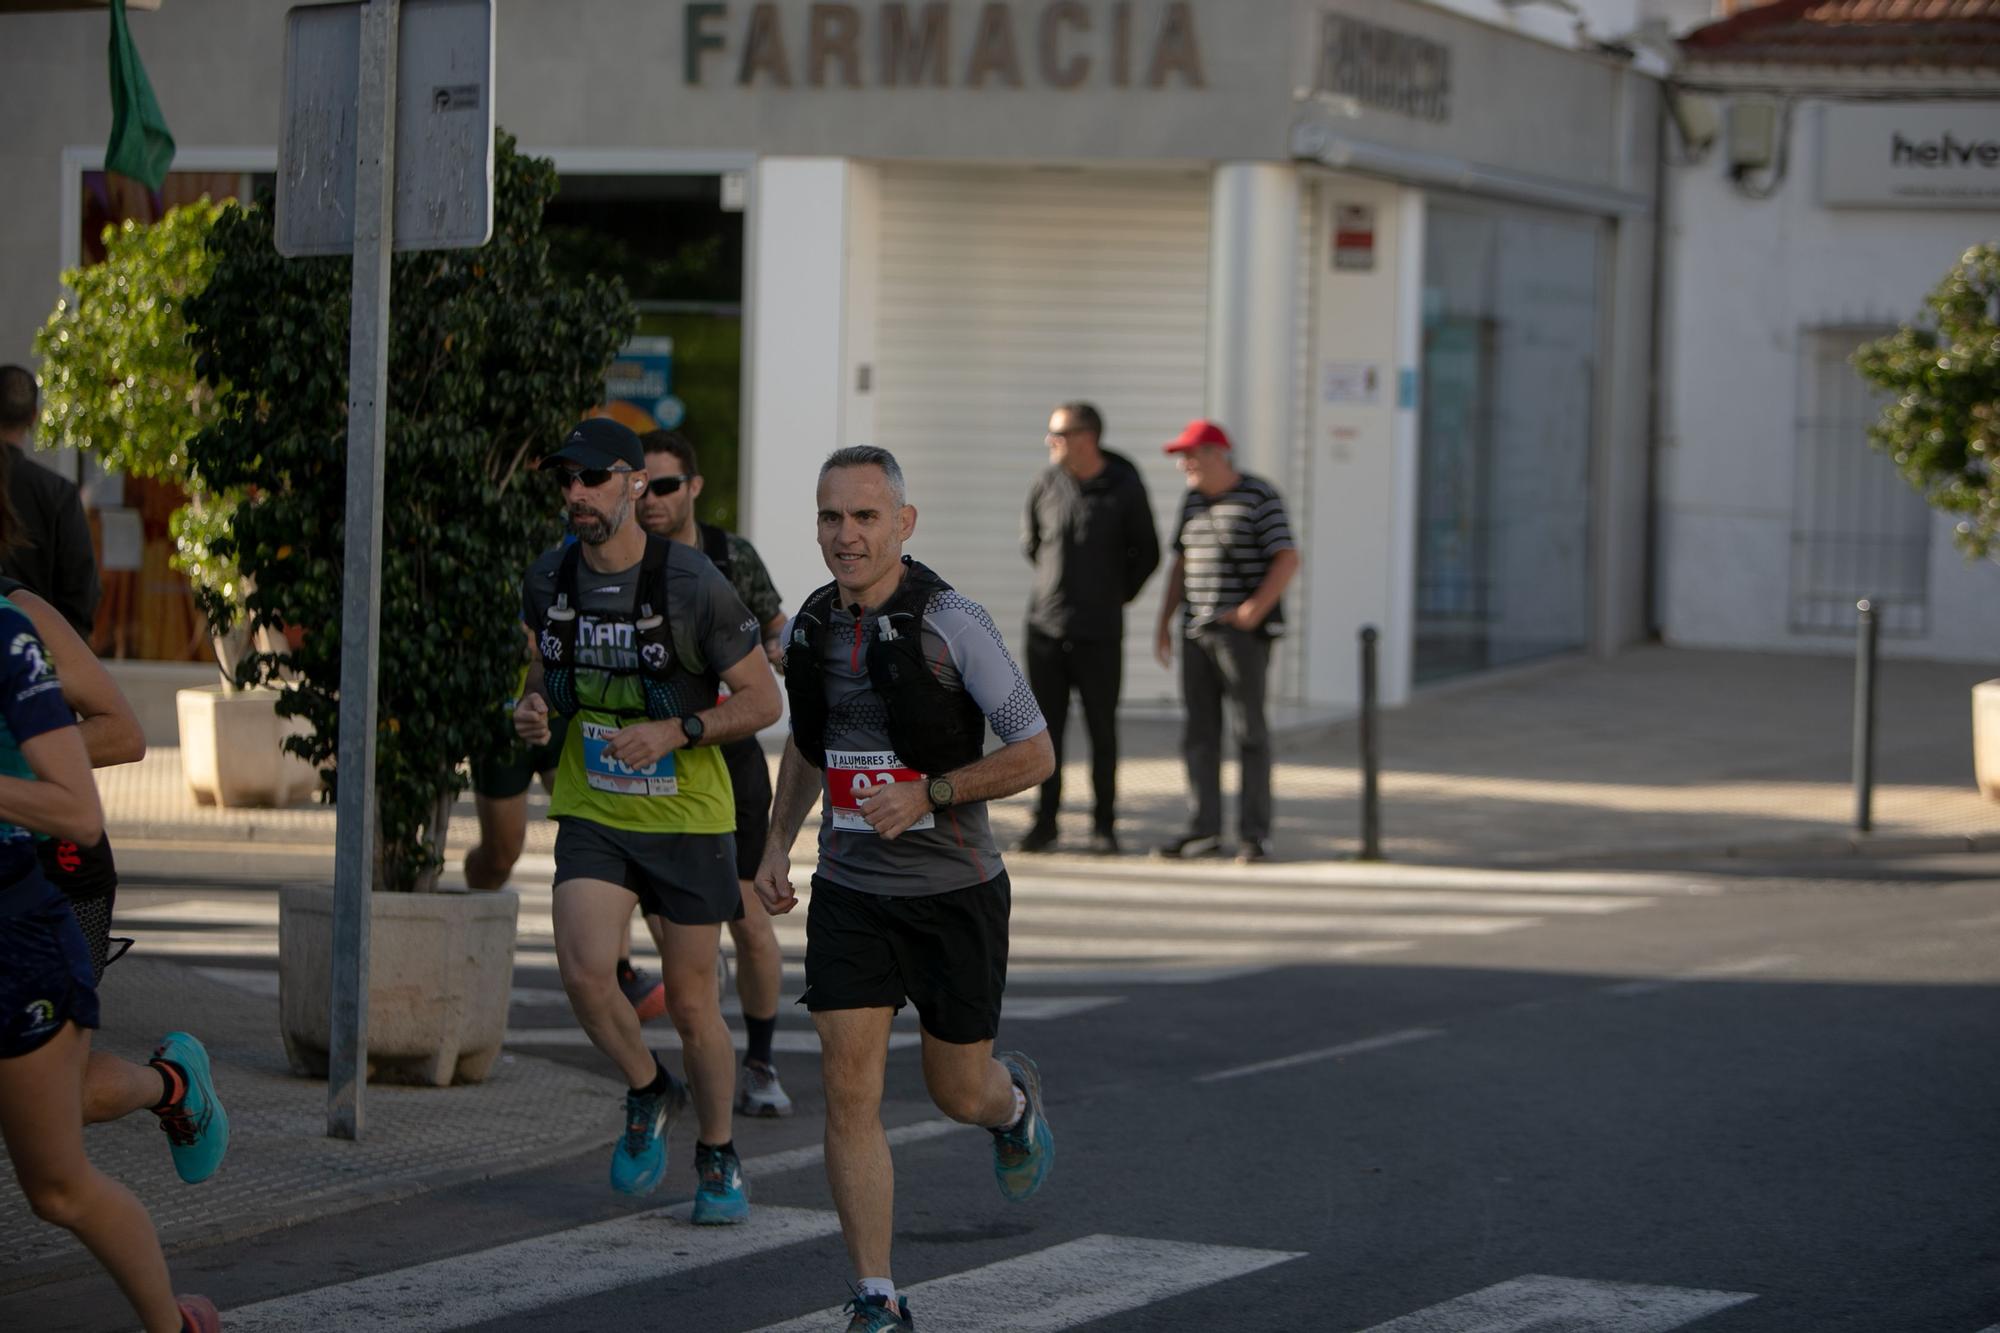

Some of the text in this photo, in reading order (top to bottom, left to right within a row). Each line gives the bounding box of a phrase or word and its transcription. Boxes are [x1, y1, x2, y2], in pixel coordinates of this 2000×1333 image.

[683, 1, 1206, 88] FARMACIA
[588, 726, 595, 738] V
[839, 755, 884, 765] ALUMBRES
